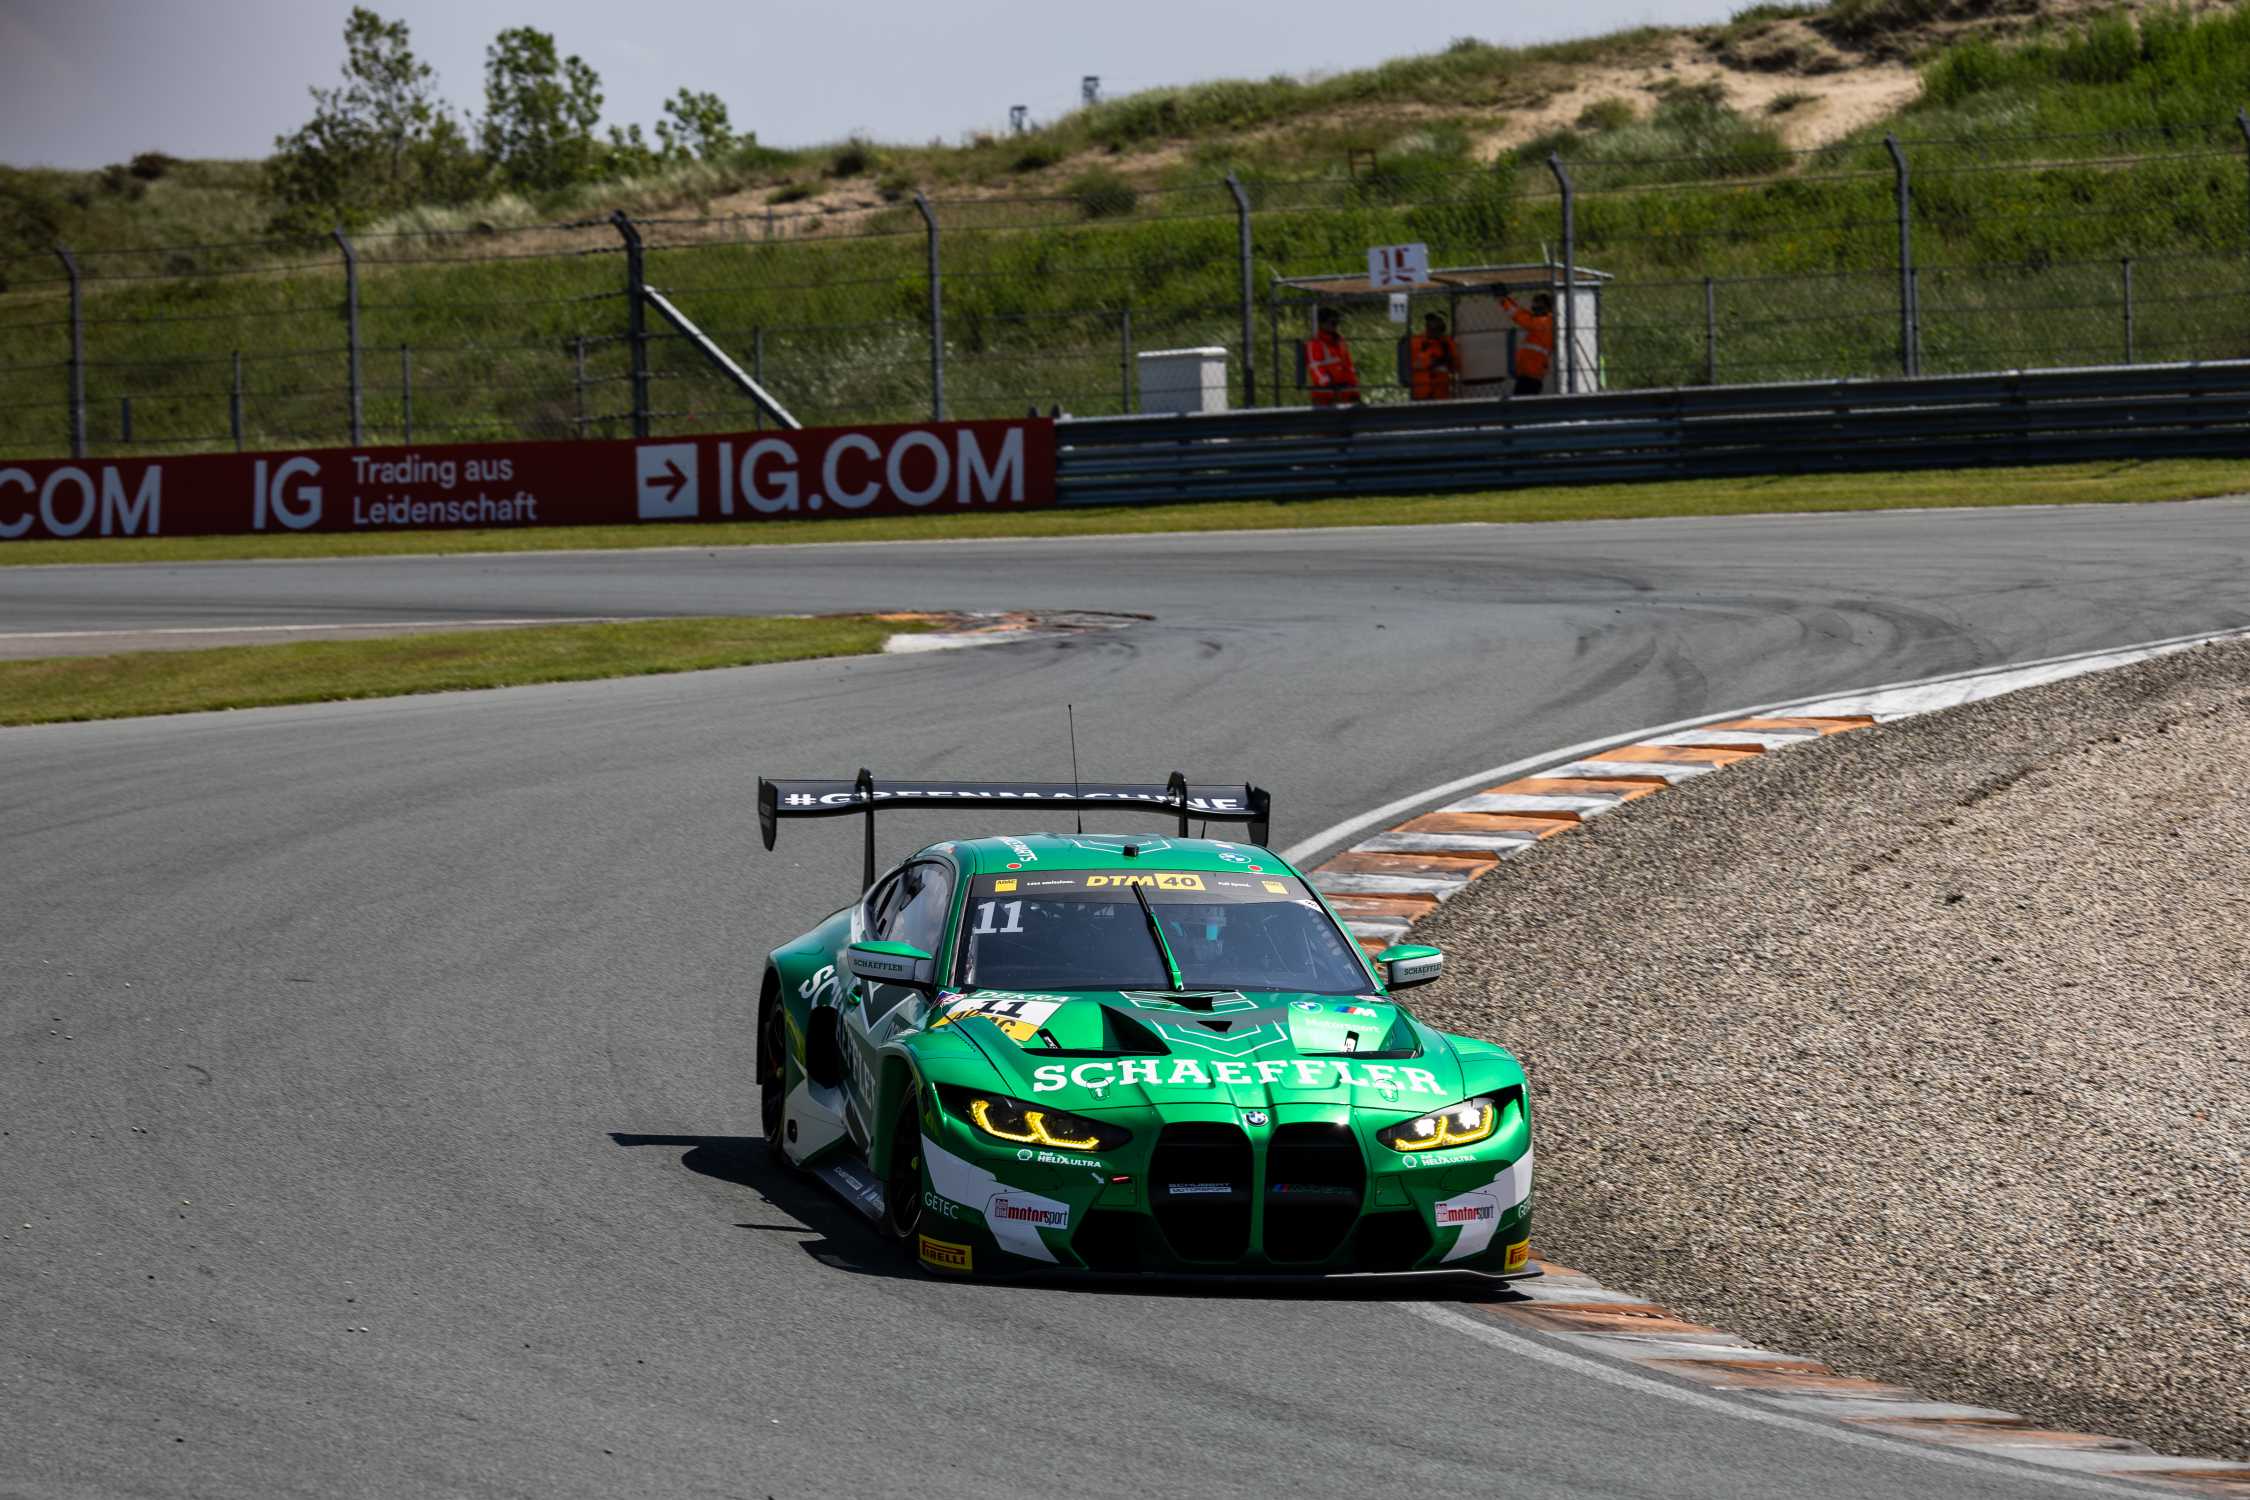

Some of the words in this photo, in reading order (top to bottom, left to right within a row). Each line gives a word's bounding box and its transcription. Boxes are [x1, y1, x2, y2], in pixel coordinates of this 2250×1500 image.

[352, 454, 457, 489] Trading
[464, 457, 513, 482] aus
[718, 427, 1025, 515] IG.COM
[252, 456, 323, 530] IG
[353, 490, 538, 525] Leidenschaft
[1086, 875, 1155, 888] DTM
[1163, 877, 1197, 887] 40
[972, 900, 1024, 934] 11
[853, 959, 903, 972] SCHAEFFLER
[971, 990, 1069, 1003] DEKRA
[978, 999, 1029, 1019] 11
[1033, 1058, 1447, 1097] SCHAEFFLER
[1038, 1153, 1070, 1165] HELIX
[1070, 1158, 1102, 1168] ULTRA
[924, 1191, 959, 1220] GETEC
[922, 1239, 965, 1265] PIRELLI
